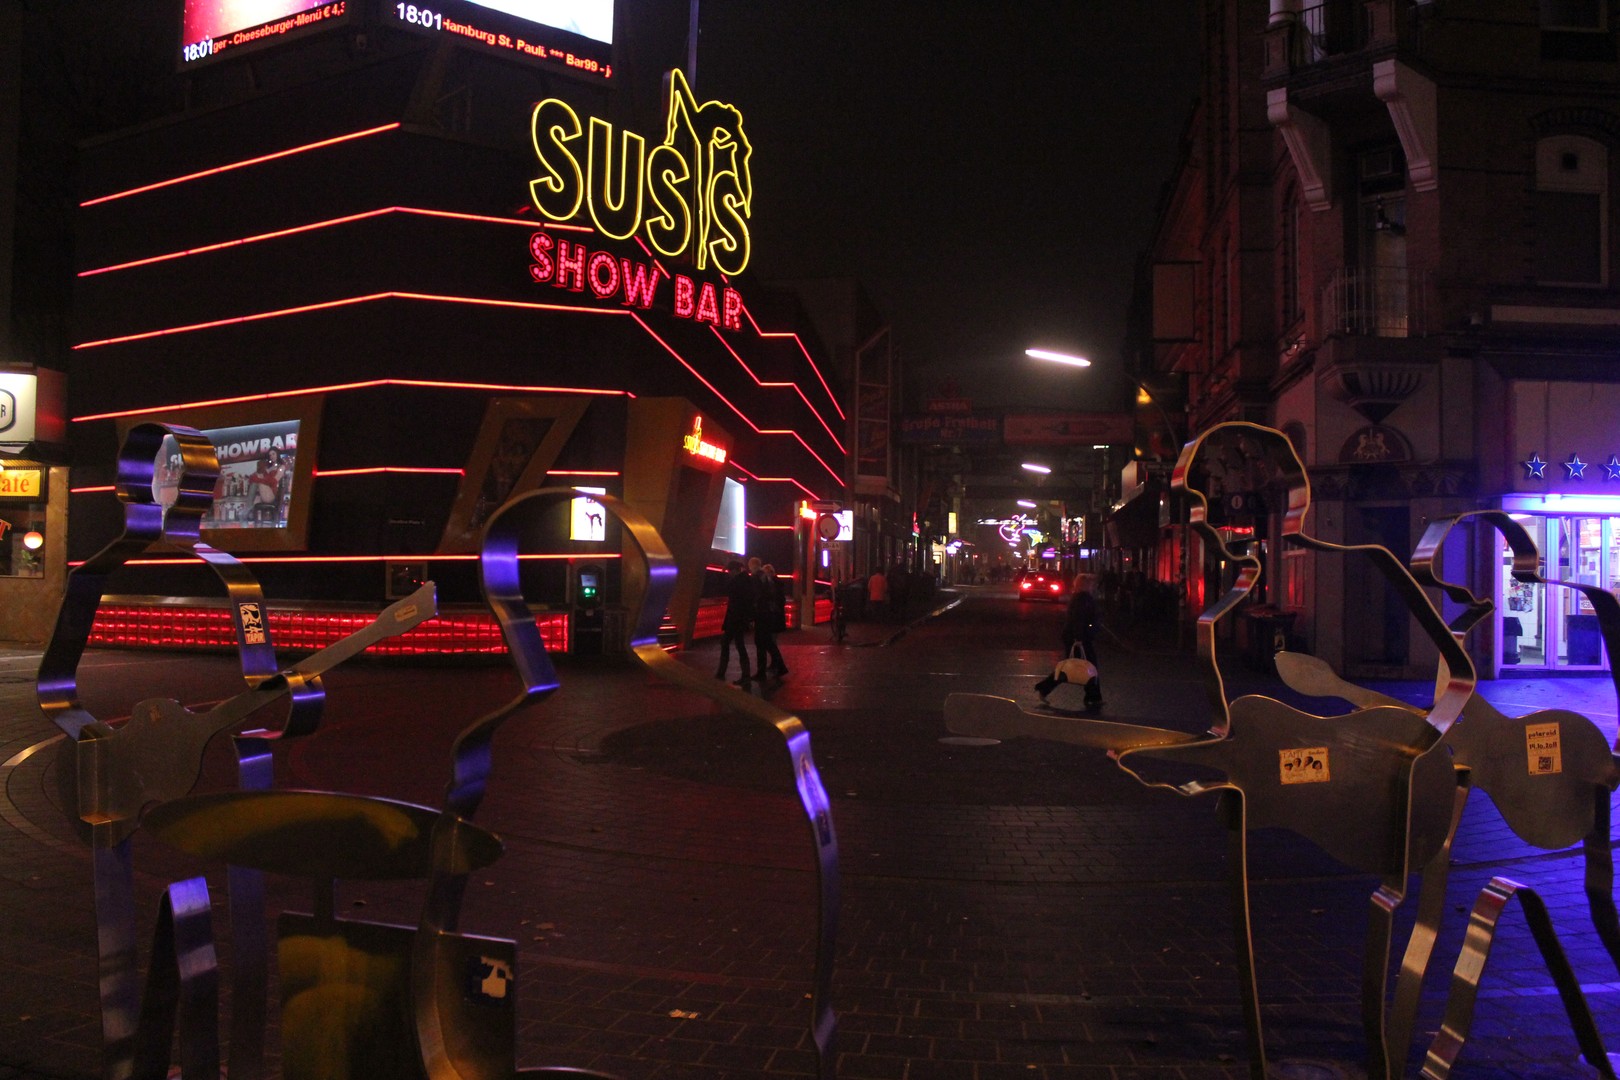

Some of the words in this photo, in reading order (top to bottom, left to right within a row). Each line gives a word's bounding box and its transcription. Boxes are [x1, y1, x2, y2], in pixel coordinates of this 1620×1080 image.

[234, 8, 322, 45] Cheeseburger-Menü
[397, 3, 442, 30] 18:01
[184, 39, 213, 62] 18:01
[498, 33, 514, 49] St.
[517, 39, 547, 58] Pauli.
[566, 53, 598, 72] Bar99
[529, 233, 661, 310] SHOW
[675, 275, 743, 332] BAR
